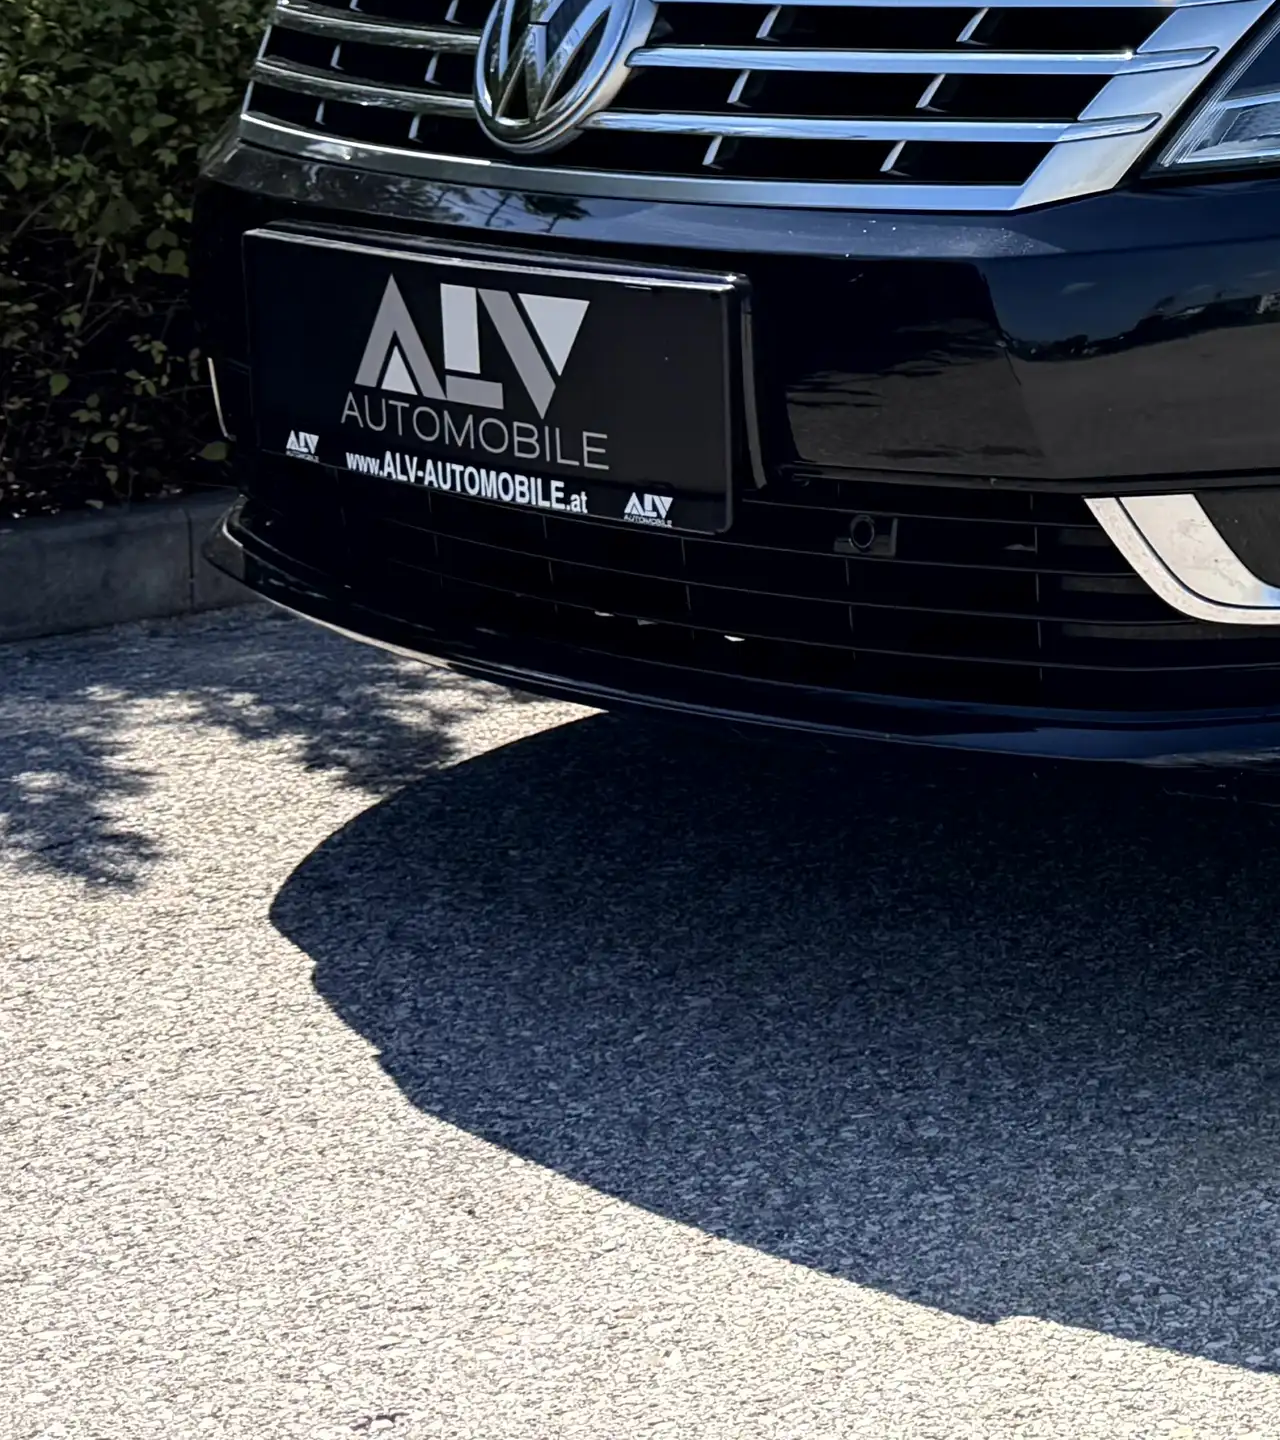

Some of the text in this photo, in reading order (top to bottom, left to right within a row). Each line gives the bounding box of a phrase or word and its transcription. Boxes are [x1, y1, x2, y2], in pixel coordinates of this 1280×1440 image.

[354, 273, 590, 419] ALV
[285, 428, 320, 455] ALV
[341, 391, 610, 470] AUTOMOBILE
[346, 450, 588, 514] www.ALV-AUTOMOBILE.at
[623, 491, 674, 519] ALV
